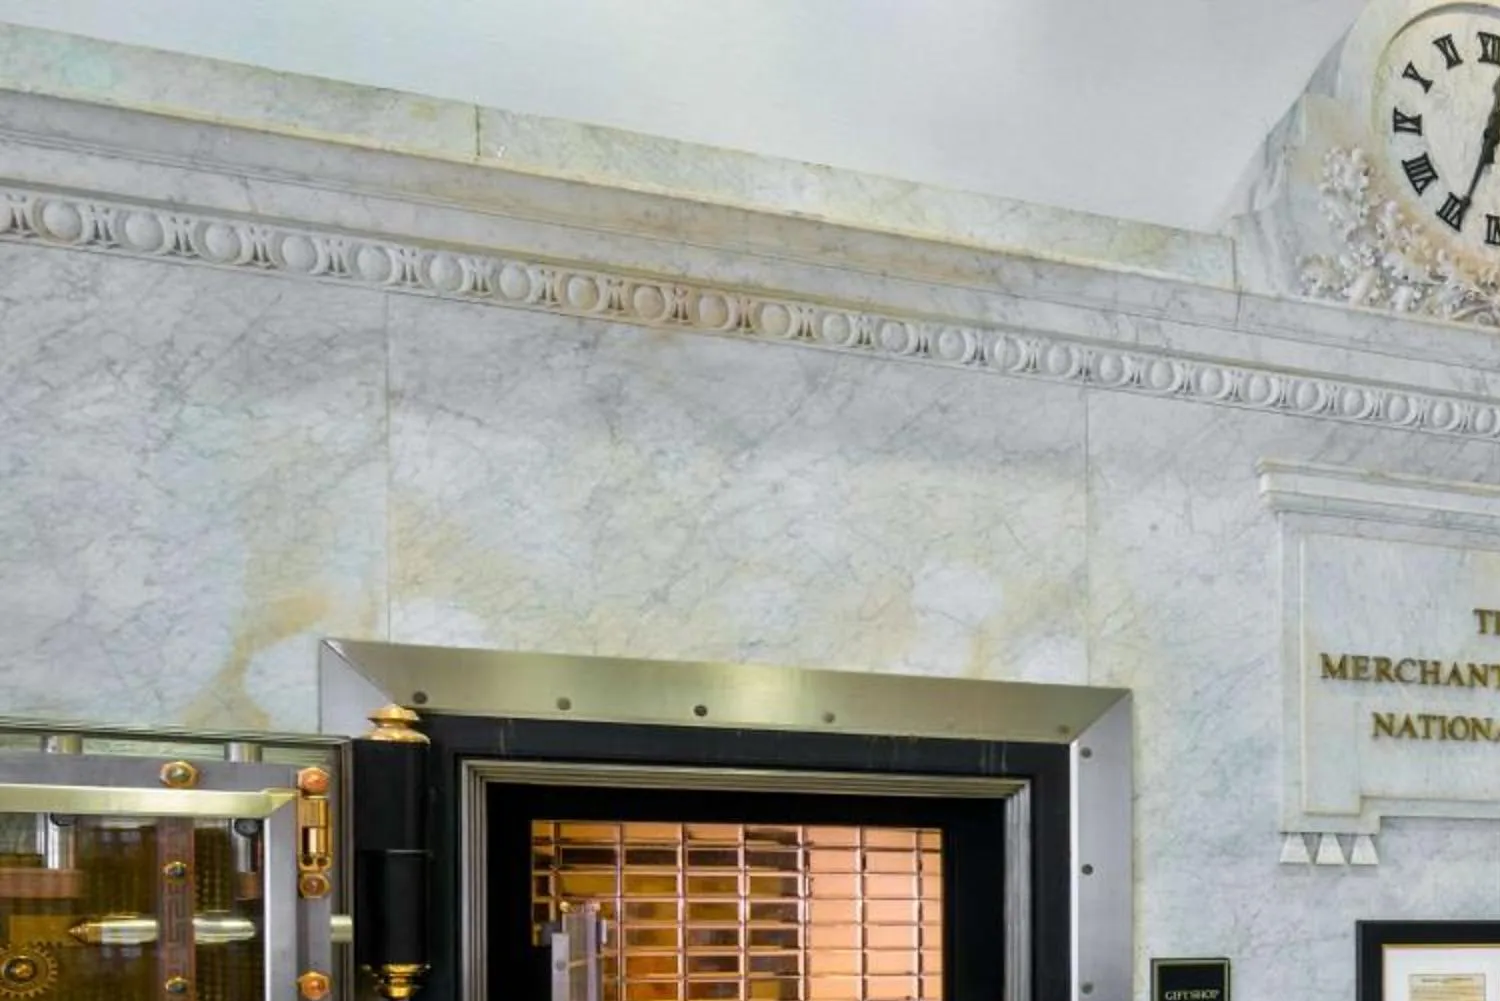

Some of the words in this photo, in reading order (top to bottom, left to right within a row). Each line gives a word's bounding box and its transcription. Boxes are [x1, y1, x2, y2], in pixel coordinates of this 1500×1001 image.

[1433, 33, 1464, 70] XI
[1392, 106, 1423, 136] IX
[1401, 152, 1438, 196] VIII
